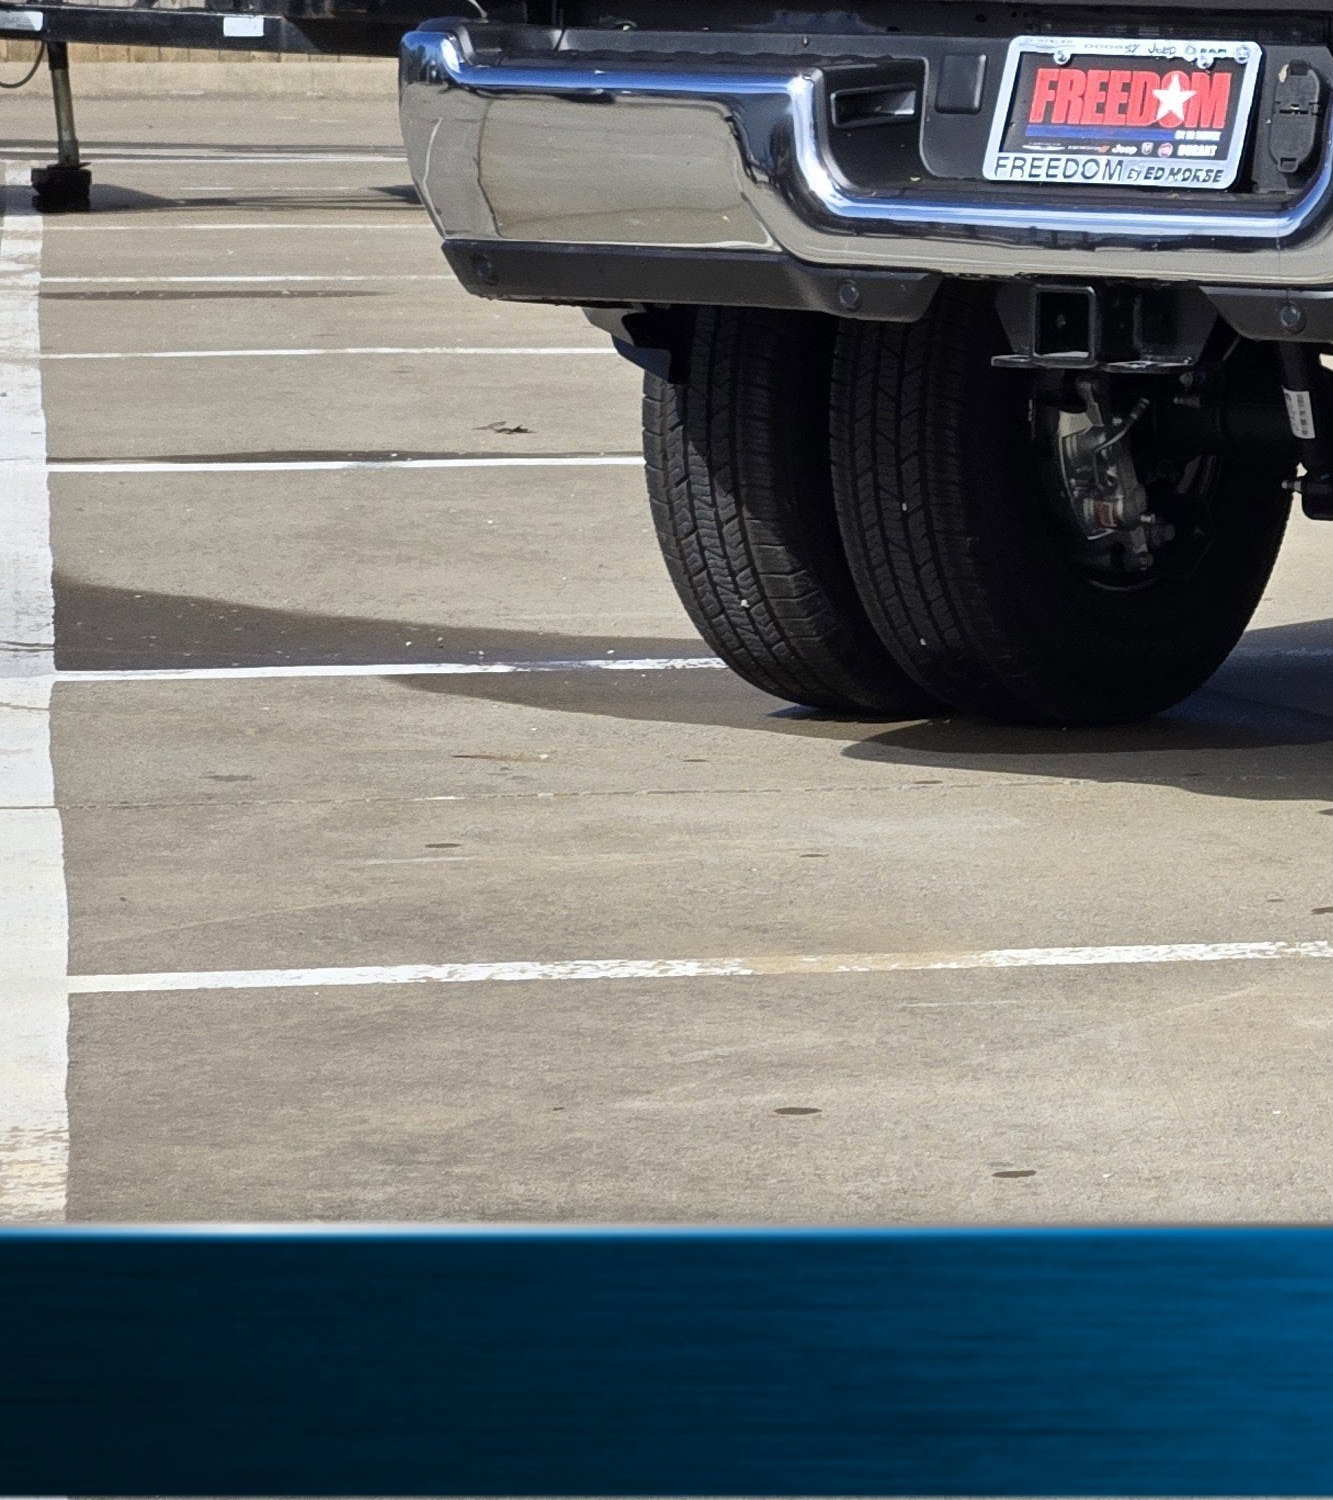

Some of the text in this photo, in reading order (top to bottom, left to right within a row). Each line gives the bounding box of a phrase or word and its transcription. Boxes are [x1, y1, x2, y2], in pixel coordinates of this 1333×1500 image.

[1028, 67, 1233, 129] FREEDOM
[994, 156, 1124, 182] FREEDOM
[1143, 167, 1162, 181] ED
